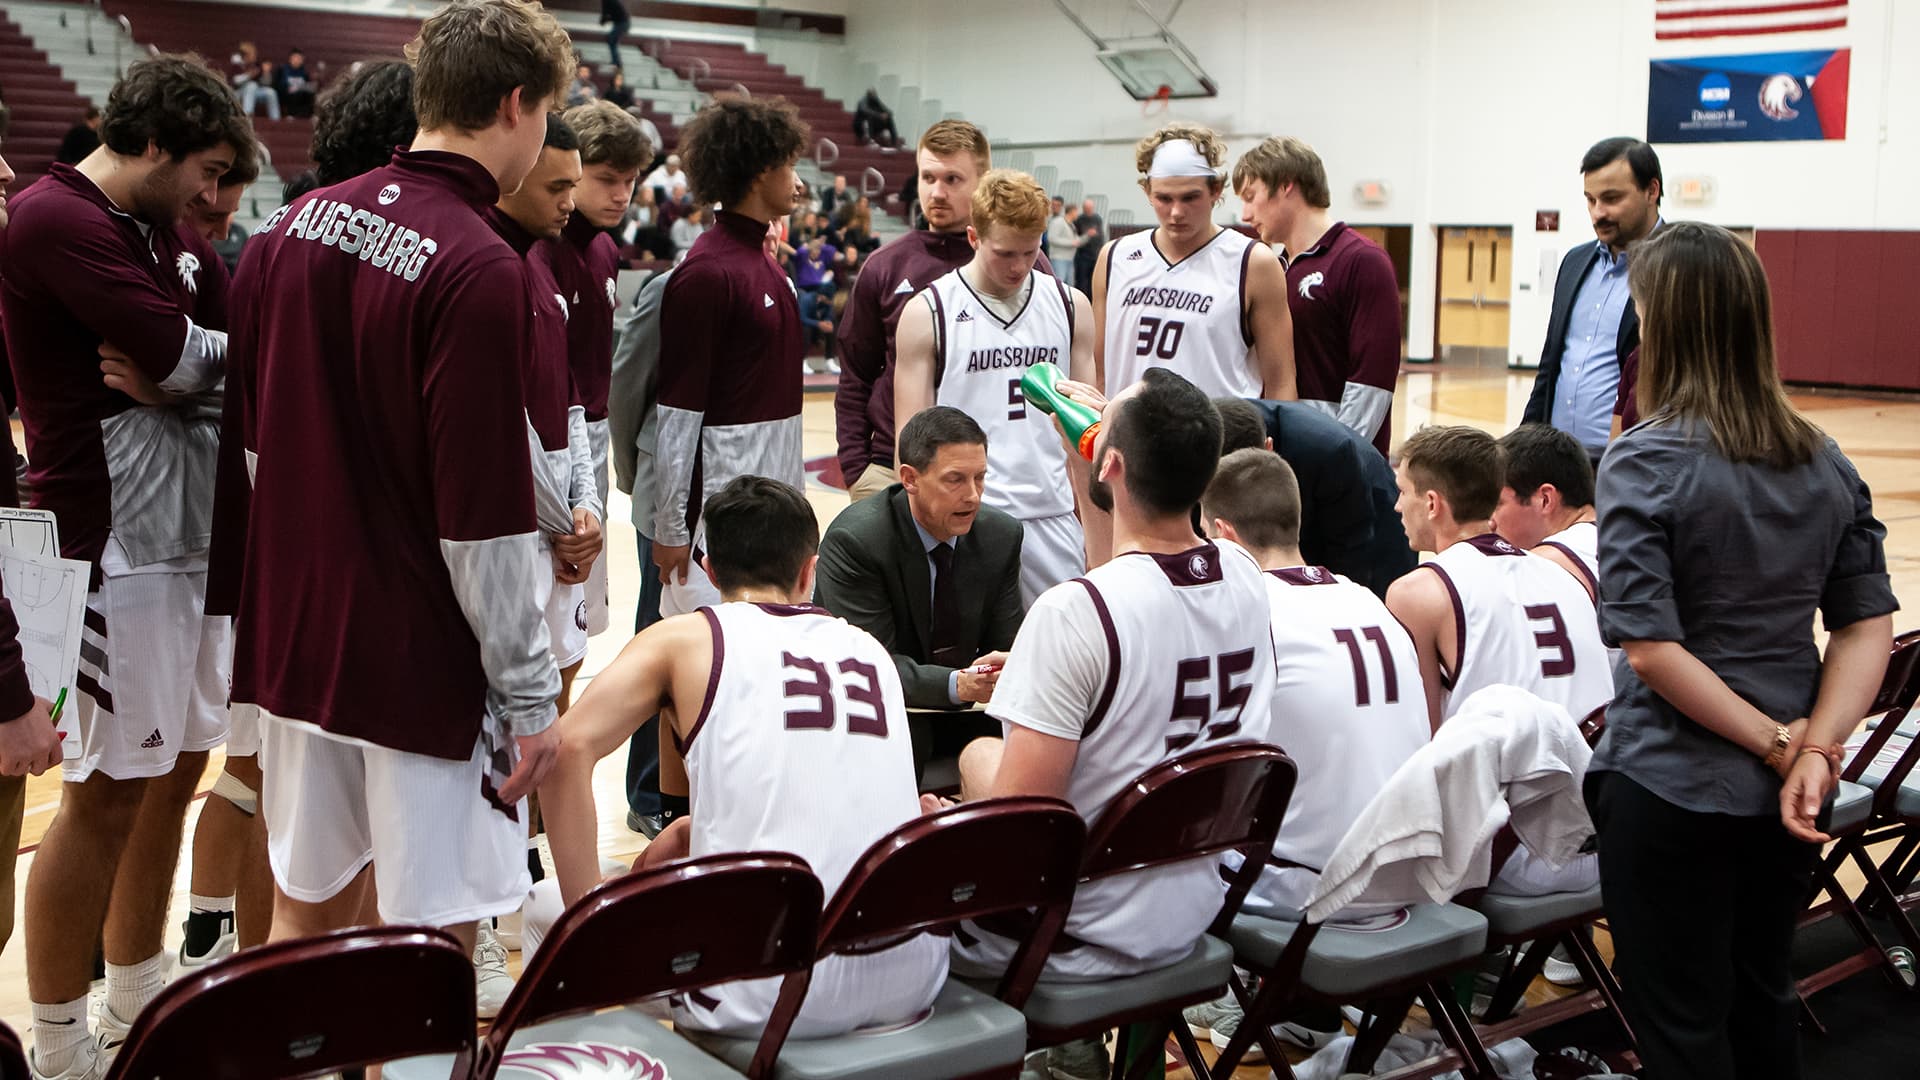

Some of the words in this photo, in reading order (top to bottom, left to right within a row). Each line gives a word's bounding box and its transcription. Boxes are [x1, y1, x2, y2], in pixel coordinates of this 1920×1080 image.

[380, 188, 399, 201] DW
[285, 198, 438, 282] AUGSBURG
[1121, 287, 1213, 314] AUGSBURG
[1136, 316, 1185, 360] 30
[966, 346, 1058, 373] AUGSBURG
[1332, 626, 1399, 707] 11
[1524, 603, 1576, 679] 3
[781, 650, 889, 740] 33
[1164, 646, 1255, 757] 55
